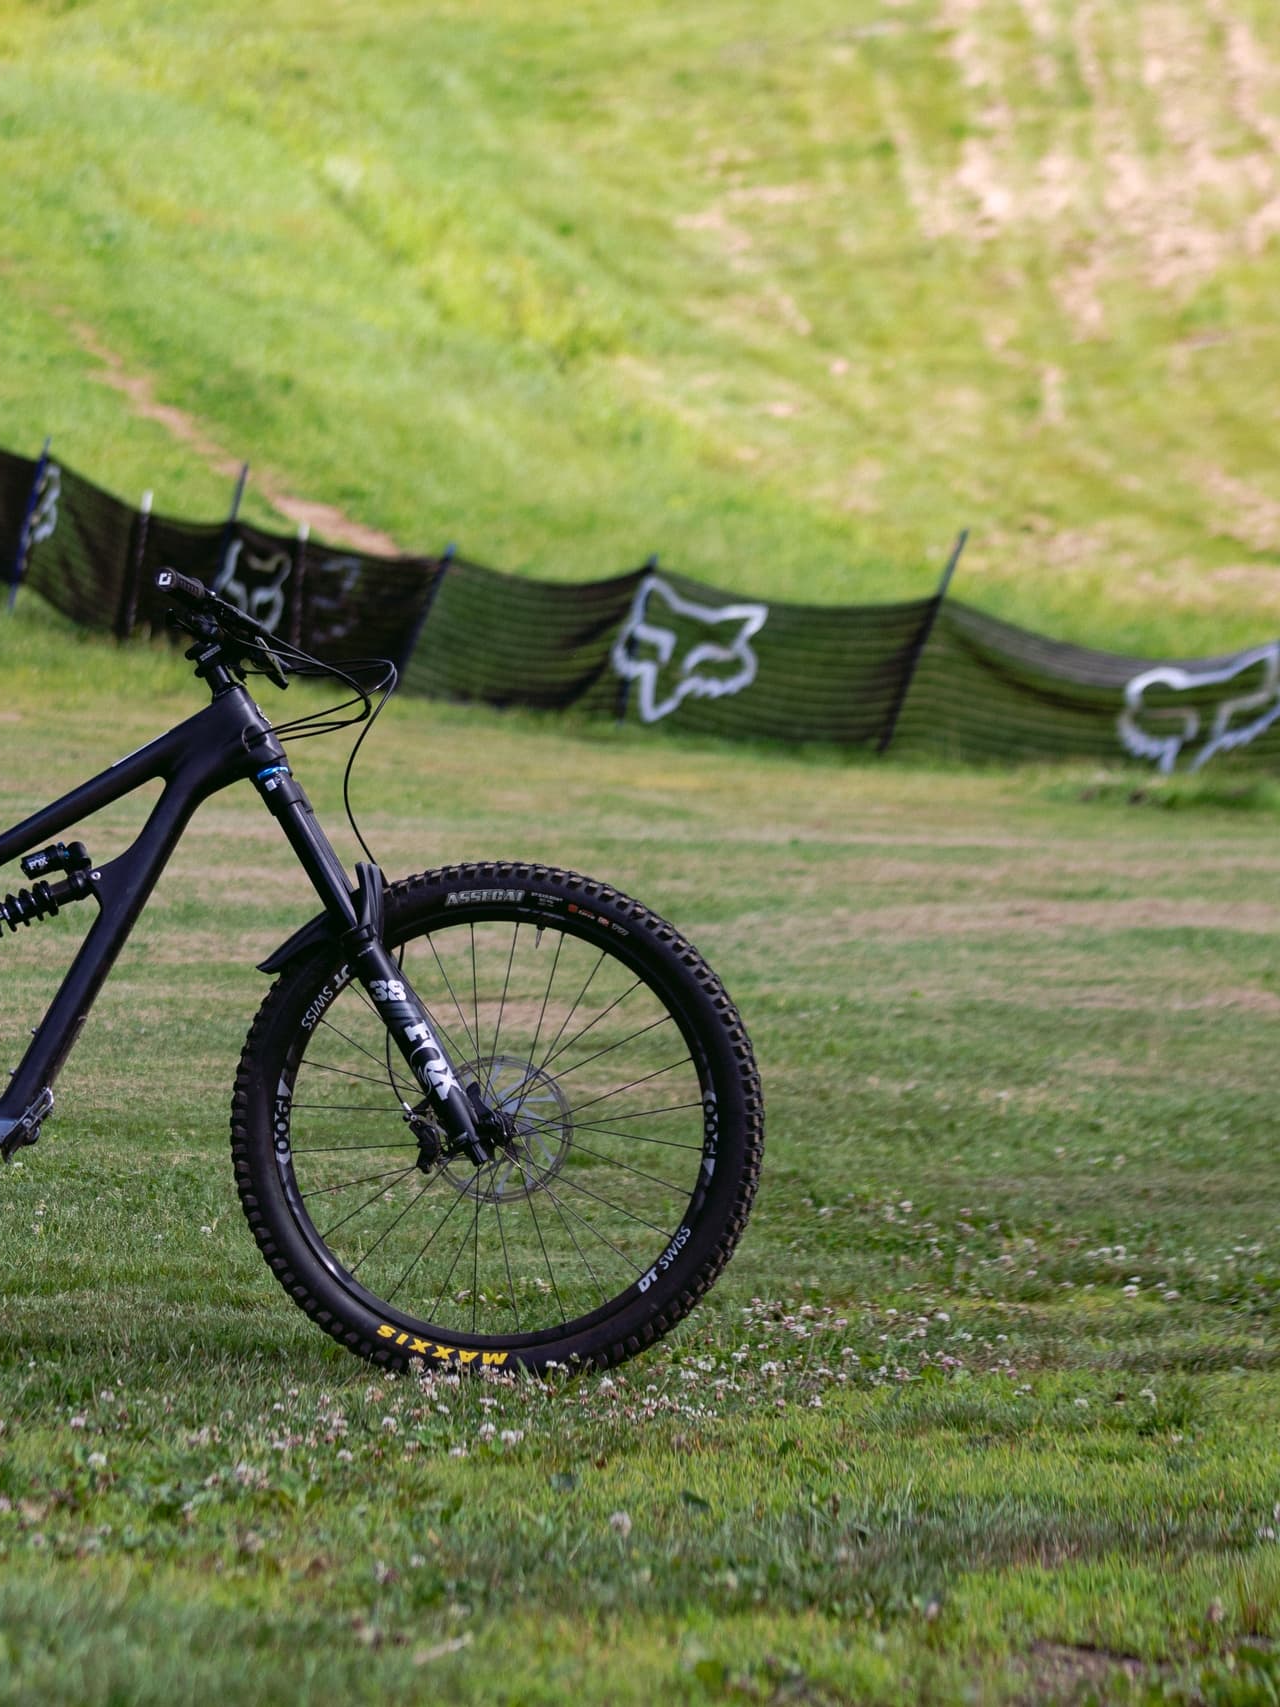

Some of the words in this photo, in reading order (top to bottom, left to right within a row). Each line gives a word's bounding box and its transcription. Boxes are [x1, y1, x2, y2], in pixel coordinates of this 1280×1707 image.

[301, 985, 333, 1031] SWISS
[369, 980, 407, 1001] 38
[404, 1020, 467, 1101] FOX
[637, 1266, 659, 1293] DT
[659, 1225, 691, 1270] SWISS
[376, 1324, 509, 1365] MAXXIS
